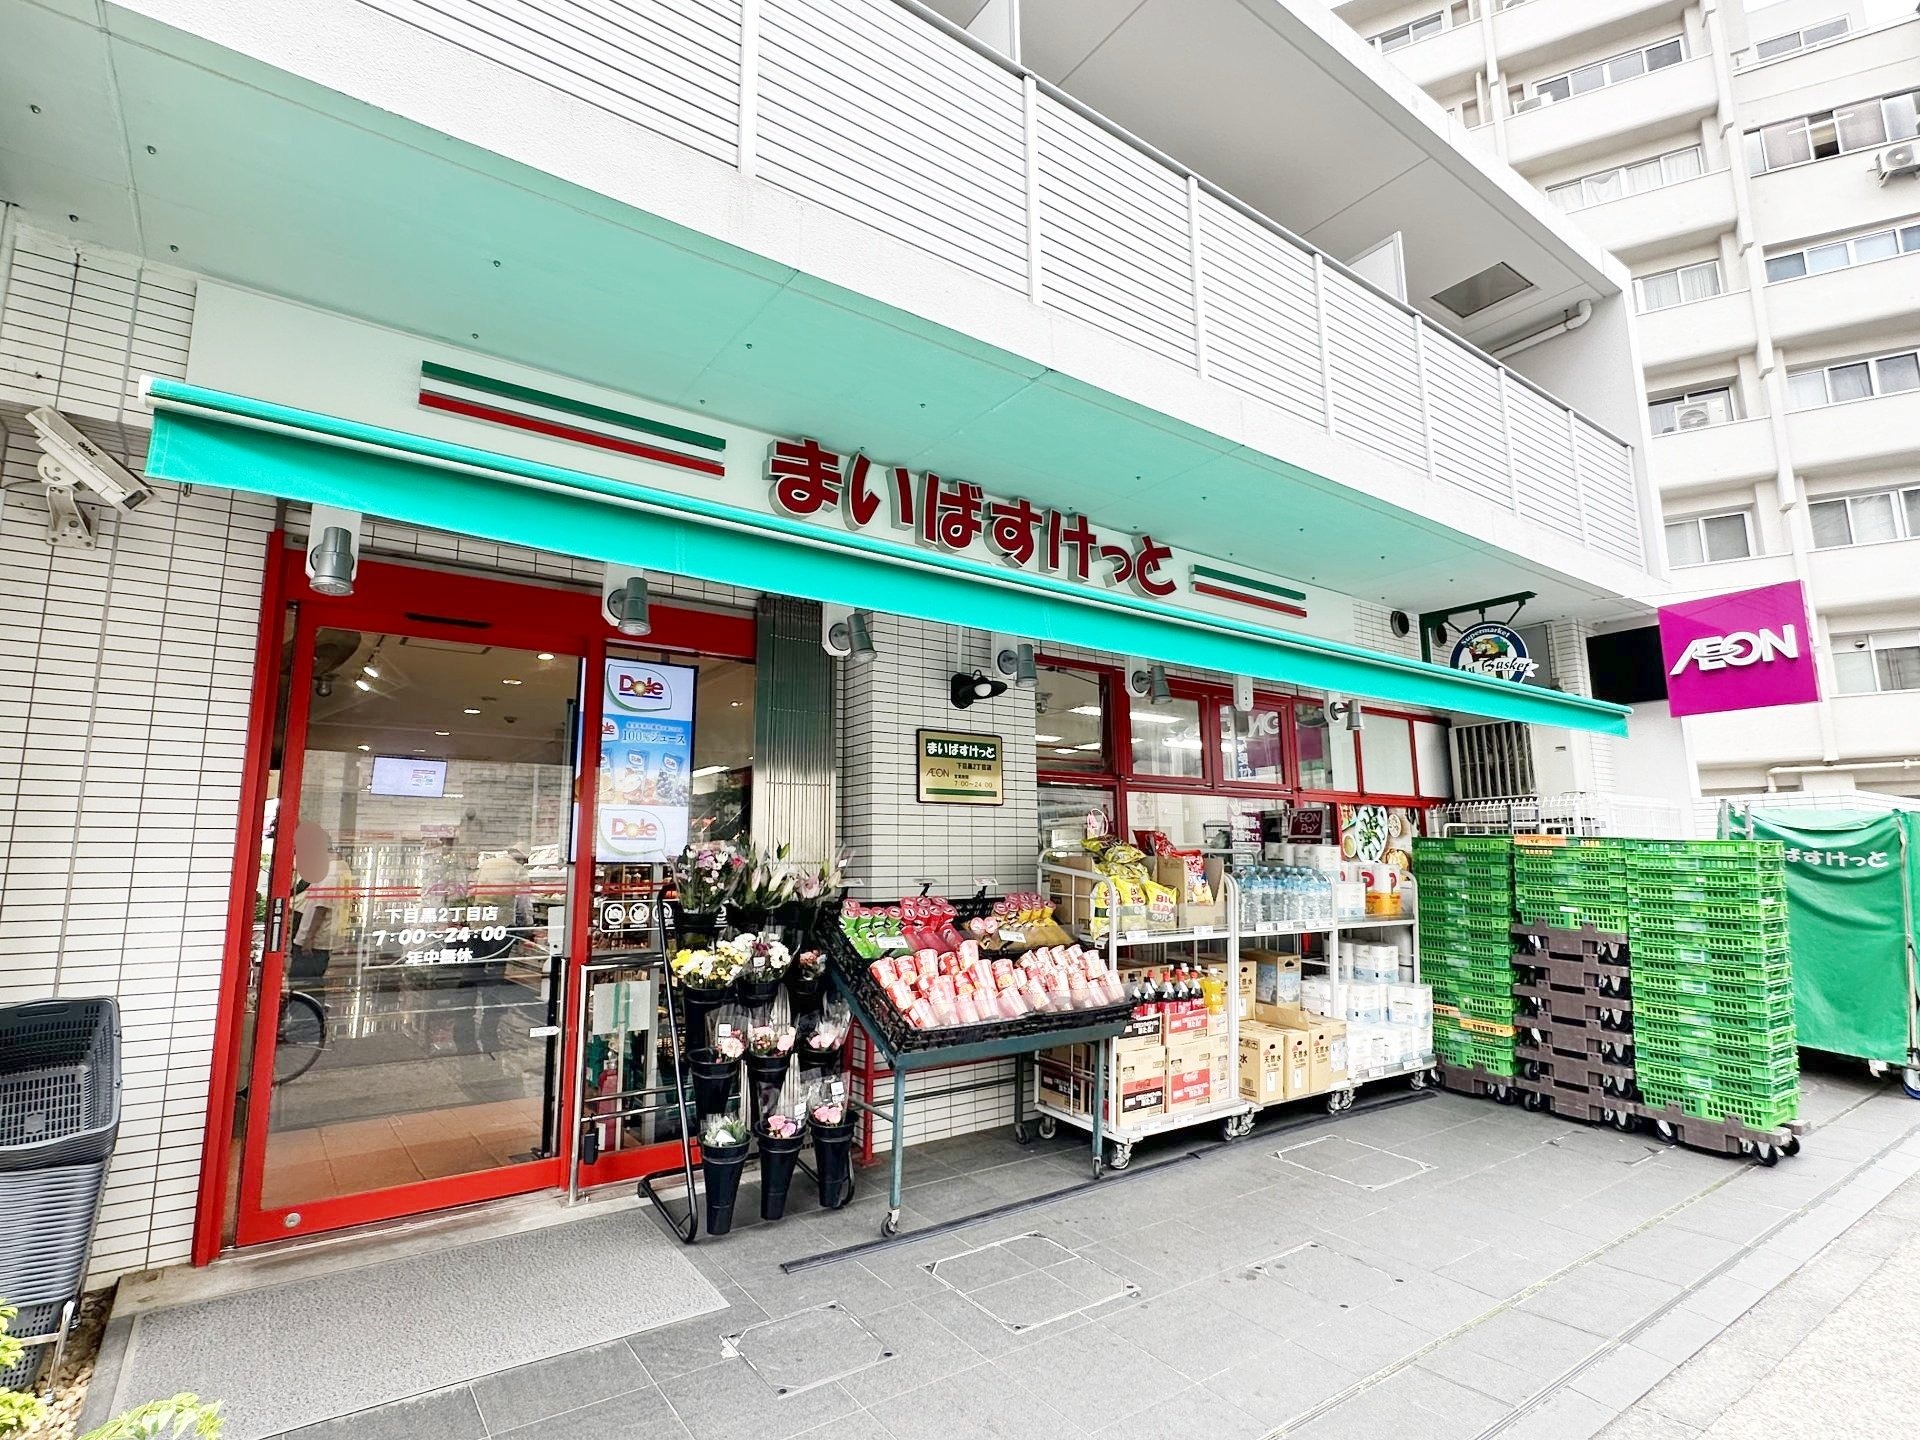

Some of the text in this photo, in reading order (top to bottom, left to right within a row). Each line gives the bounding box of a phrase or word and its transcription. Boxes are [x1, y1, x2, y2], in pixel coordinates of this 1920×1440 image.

[766, 437, 1178, 599] まいばすけっと
[1460, 627, 1511, 645] Supermarket
[1482, 657, 1530, 673] Basket
[619, 674, 664, 697] Dole
[926, 742, 996, 758] まいばすけっと
[610, 817, 658, 838] Dole
[384, 906, 500, 924] 下目黒2丁目店
[405, 947, 474, 966] 年中無休
